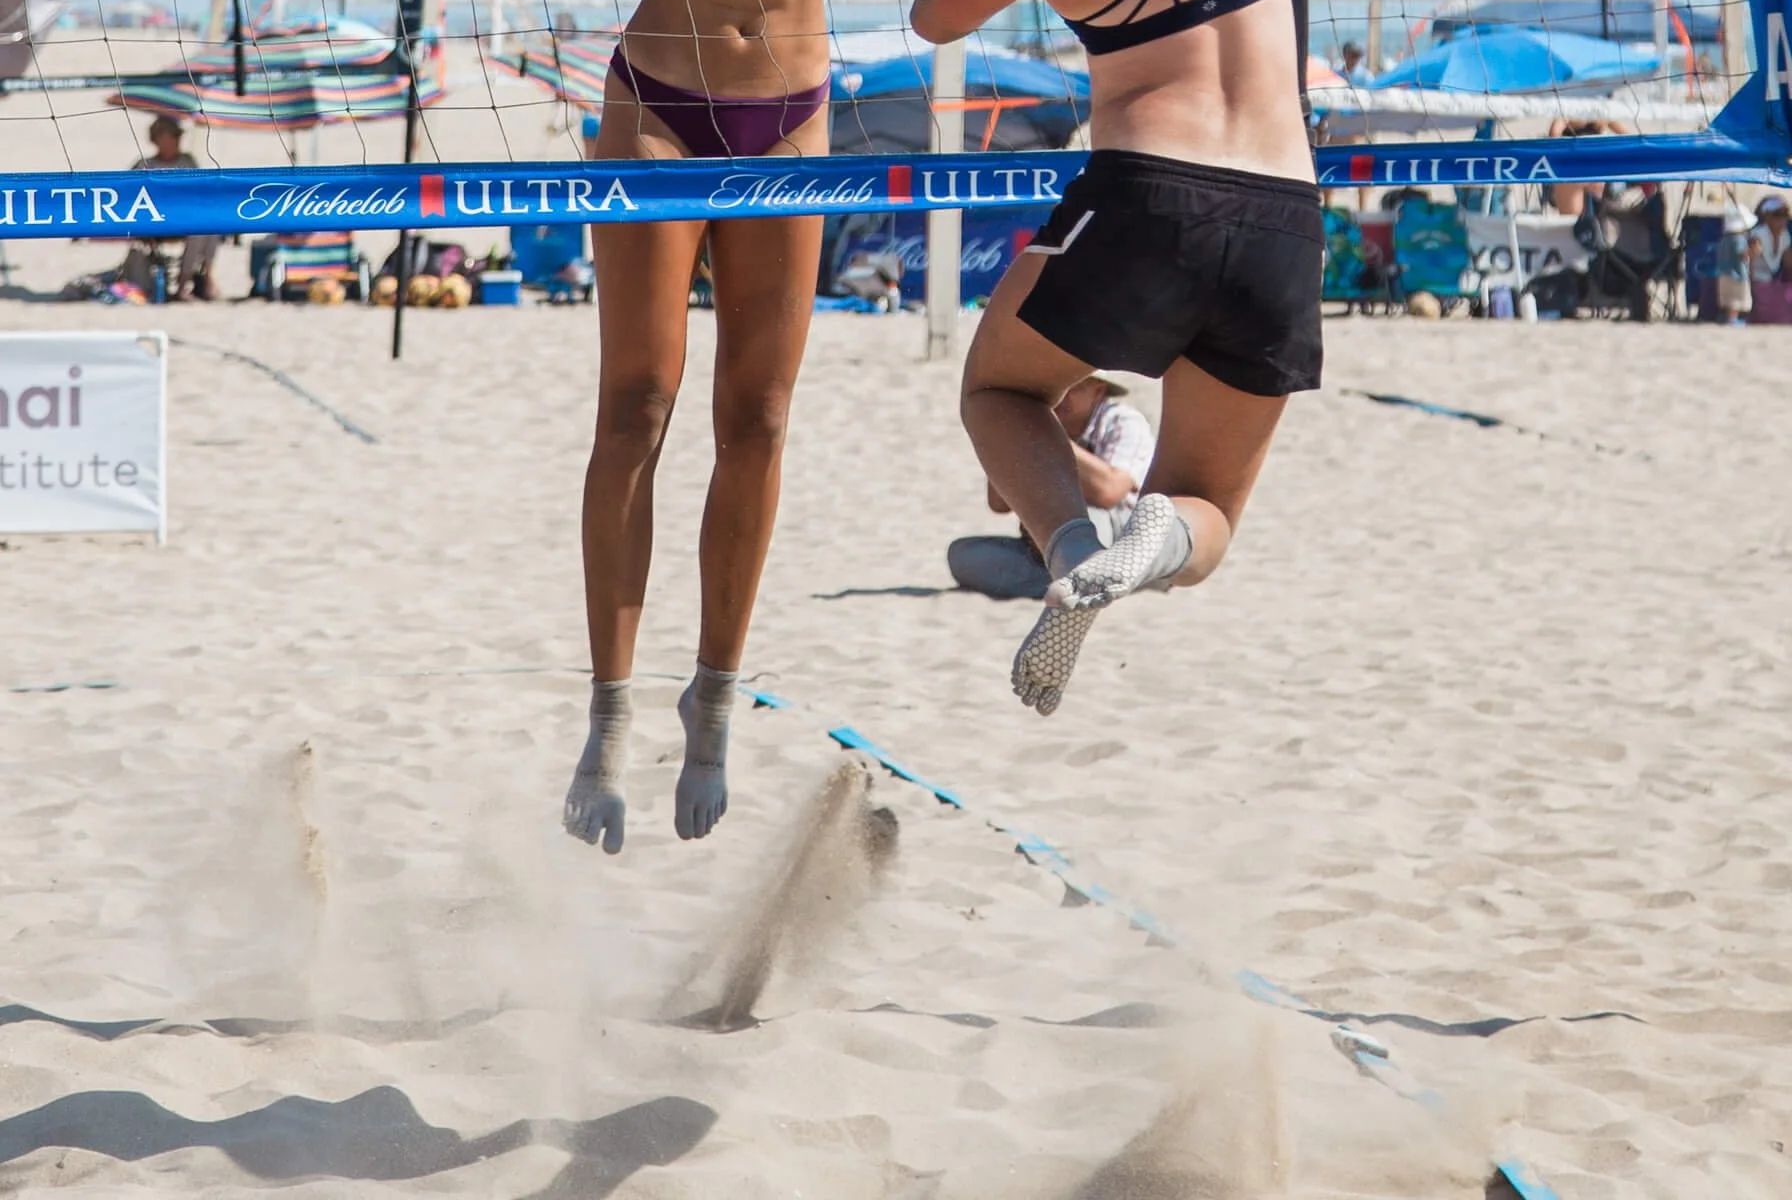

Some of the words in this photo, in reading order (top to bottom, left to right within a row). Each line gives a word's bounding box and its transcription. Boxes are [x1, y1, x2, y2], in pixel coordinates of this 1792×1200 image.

[236, 183, 406, 219] Michelob
[454, 177, 640, 215] ULTRA
[708, 174, 878, 208] Michelob
[922, 167, 1086, 203] ULTR
[0, 365, 82, 429] ai
